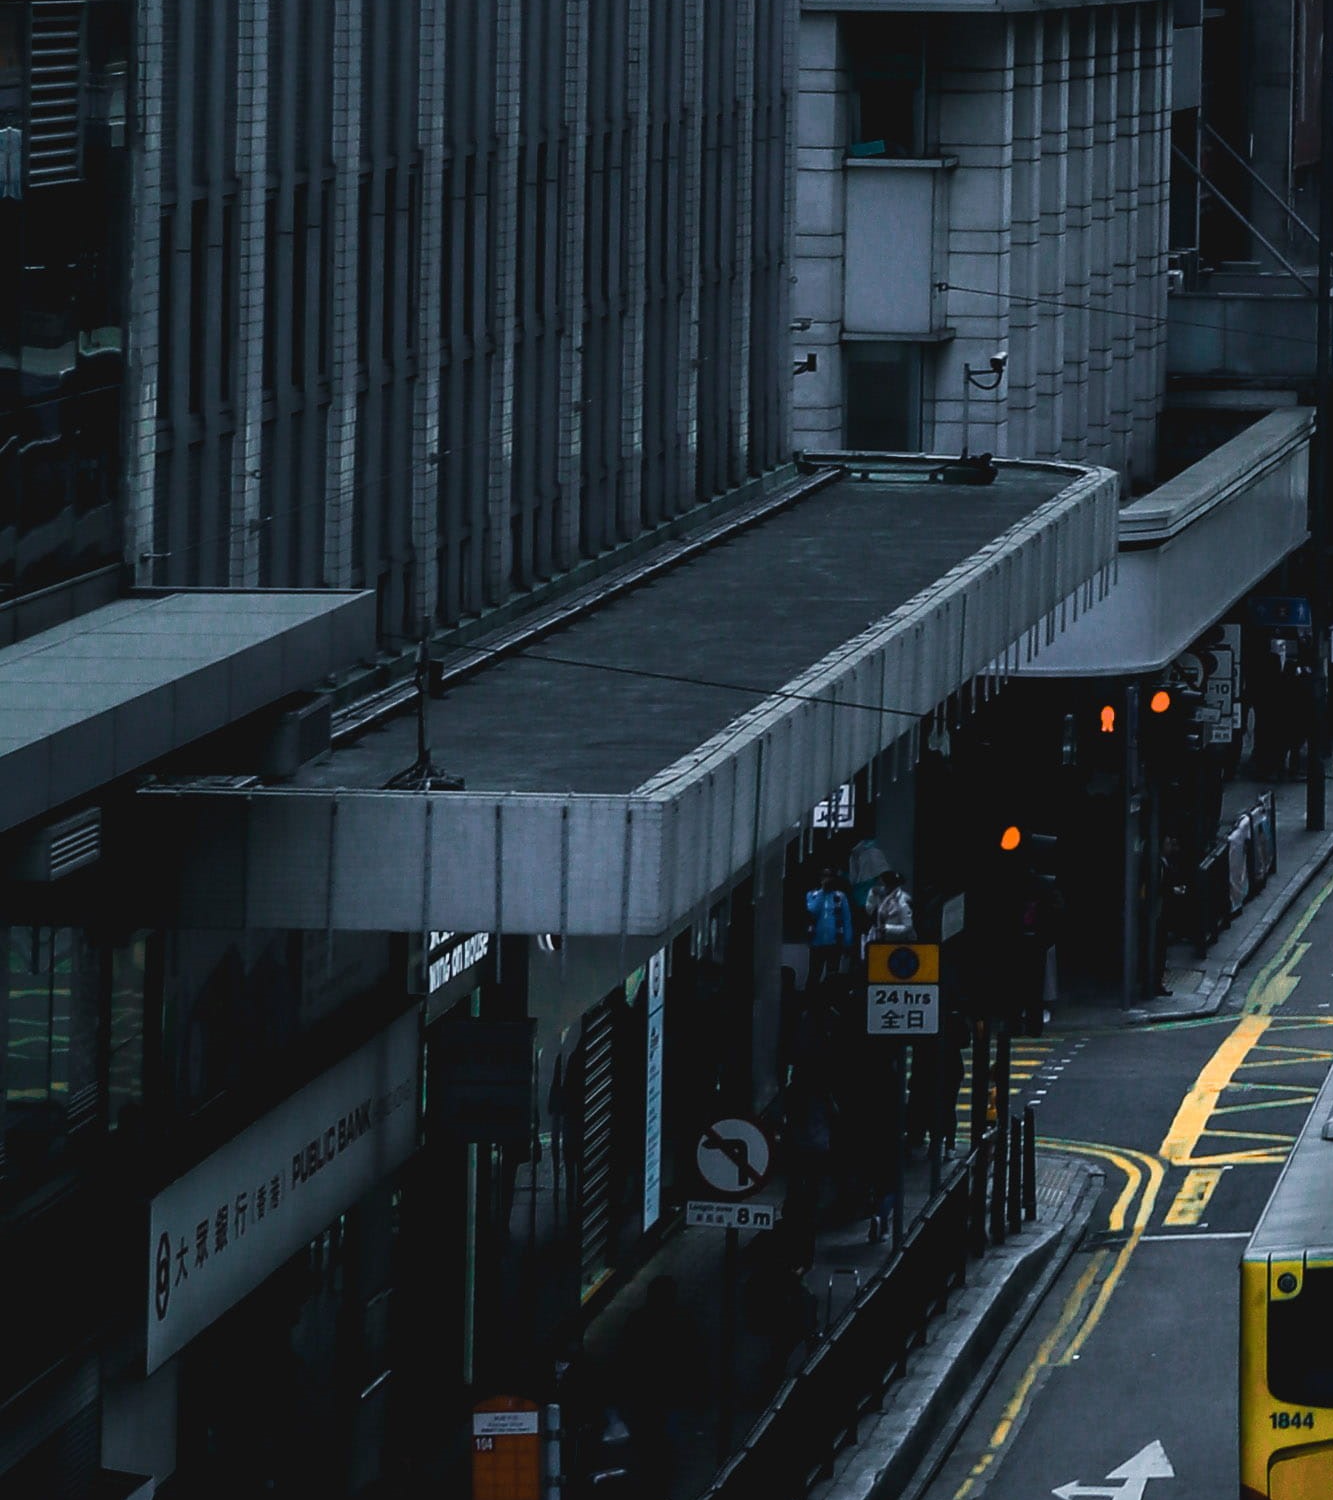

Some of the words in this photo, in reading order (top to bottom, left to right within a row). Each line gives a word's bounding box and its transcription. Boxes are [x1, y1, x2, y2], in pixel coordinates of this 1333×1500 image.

[875, 990, 899, 1005] 24
[903, 990, 932, 1005] hrs
[881, 1010, 925, 1029] 全日
[338, 1099, 372, 1154] BANK
[737, 1207, 750, 1225] 8
[1269, 1412, 1315, 1431] 1844
